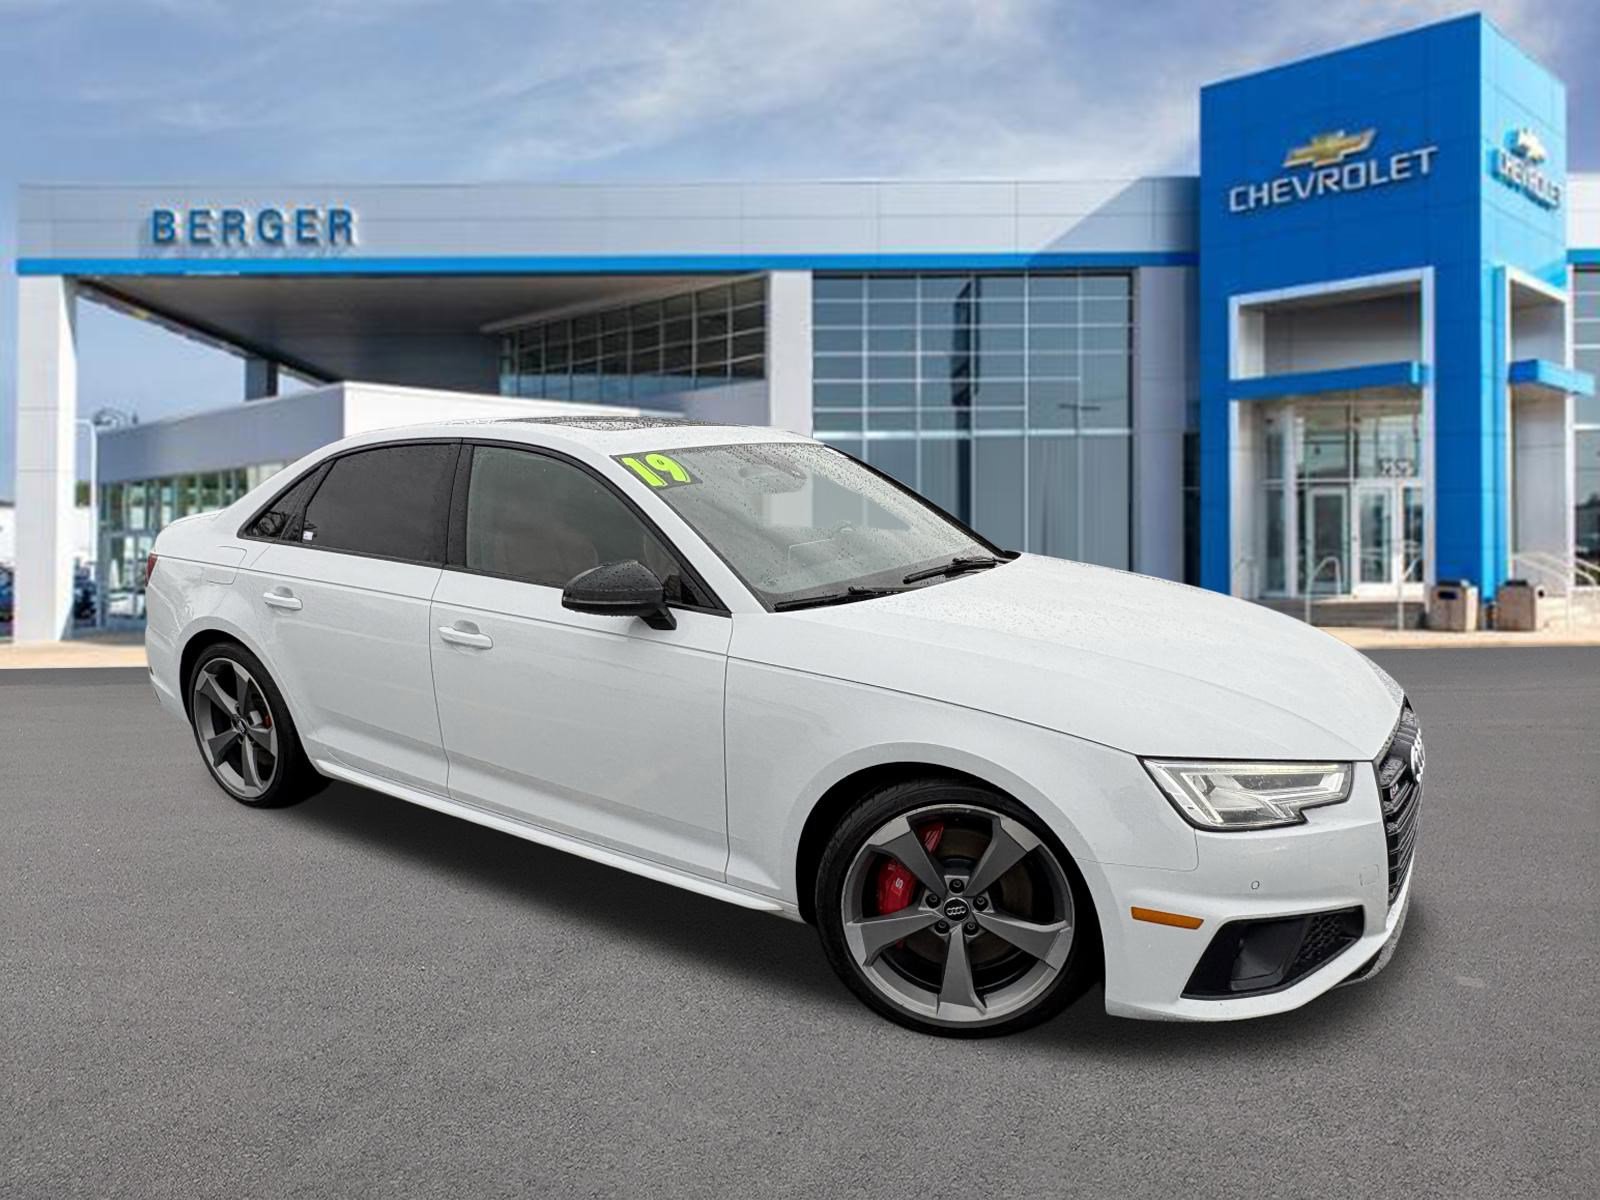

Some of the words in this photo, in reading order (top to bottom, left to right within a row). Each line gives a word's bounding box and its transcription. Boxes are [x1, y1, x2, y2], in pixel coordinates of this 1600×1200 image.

[1229, 146, 1438, 213] CHEVROLET
[1497, 147, 1562, 207] CHEVROLE
[152, 208, 356, 245] BERGER
[621, 453, 691, 487] 19
